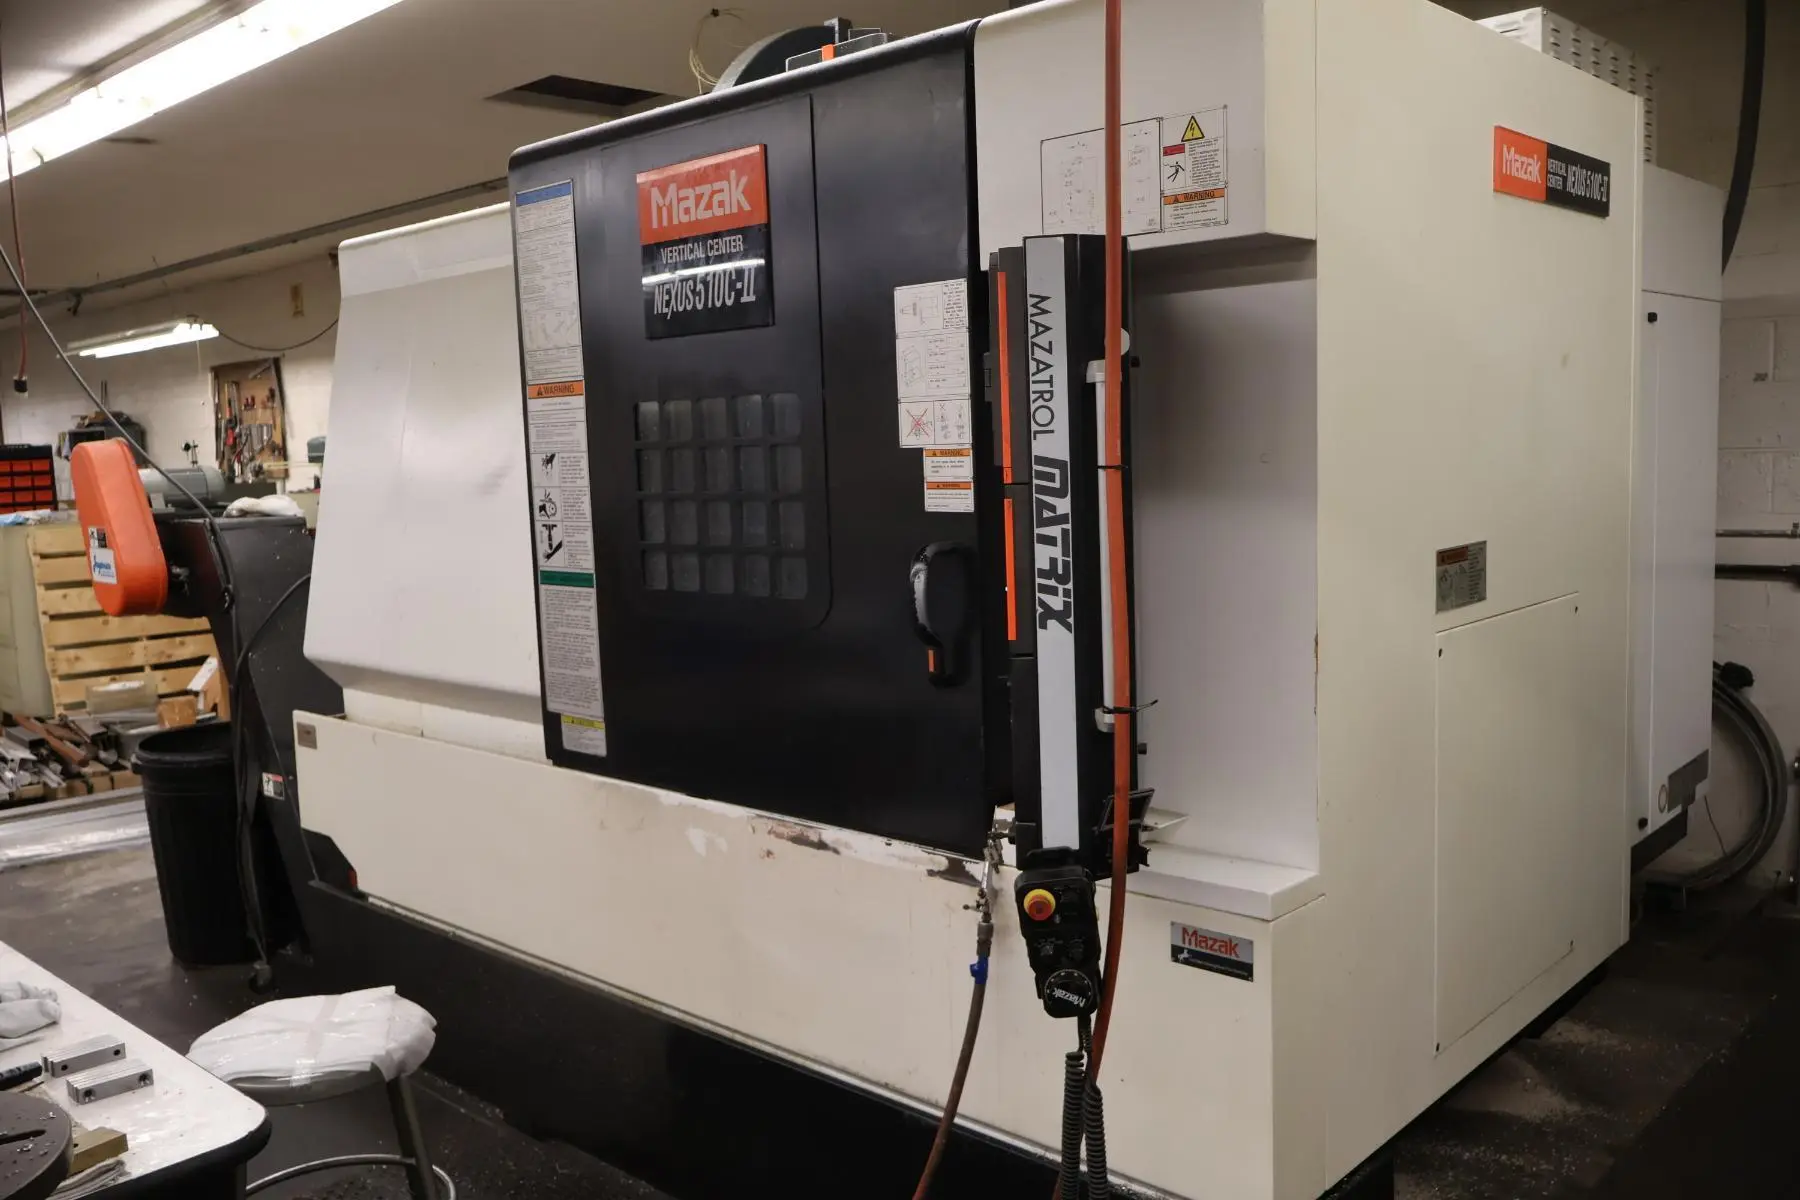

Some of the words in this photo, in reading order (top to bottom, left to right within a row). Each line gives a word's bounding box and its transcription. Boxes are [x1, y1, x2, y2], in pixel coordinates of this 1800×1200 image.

[1502, 144, 1541, 183] Mazak
[1547, 158, 1567, 176] VERTICAL
[651, 169, 751, 228] Mazak
[1183, 190, 1215, 201] WARNING
[661, 241, 705, 264] VERTICAL
[707, 234, 744, 257] CENTER
[1028, 293, 1055, 441] MAZATROL
[544, 383, 575, 395] WARNING
[1182, 926, 1240, 959] Mazak
[1052, 987, 1086, 1008] Mazak
